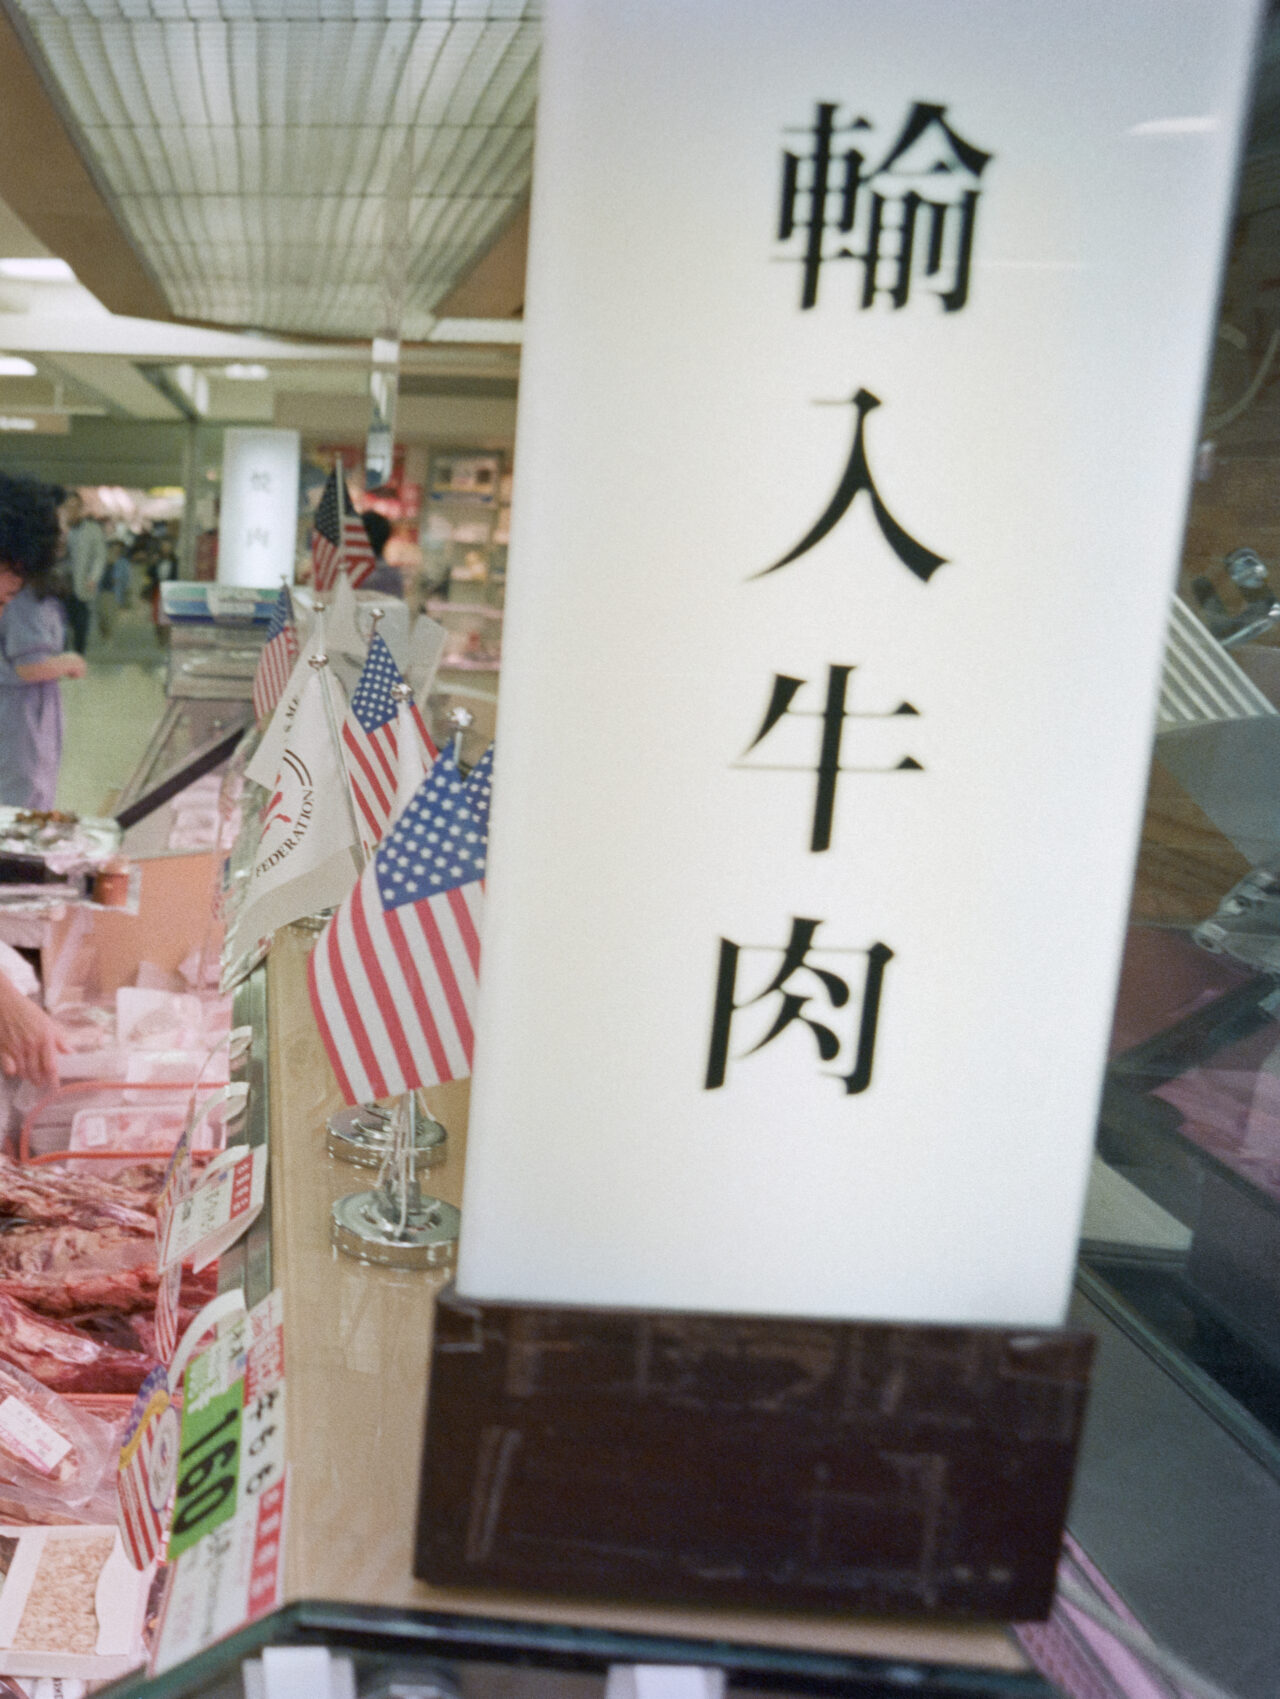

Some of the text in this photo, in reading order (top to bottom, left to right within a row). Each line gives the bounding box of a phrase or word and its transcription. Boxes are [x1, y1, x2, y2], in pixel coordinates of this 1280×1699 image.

[704, 100, 993, 1095] 輸入牛肉
[256, 789, 314, 878] FEDERATION
[172, 1408, 239, 1535] 160
